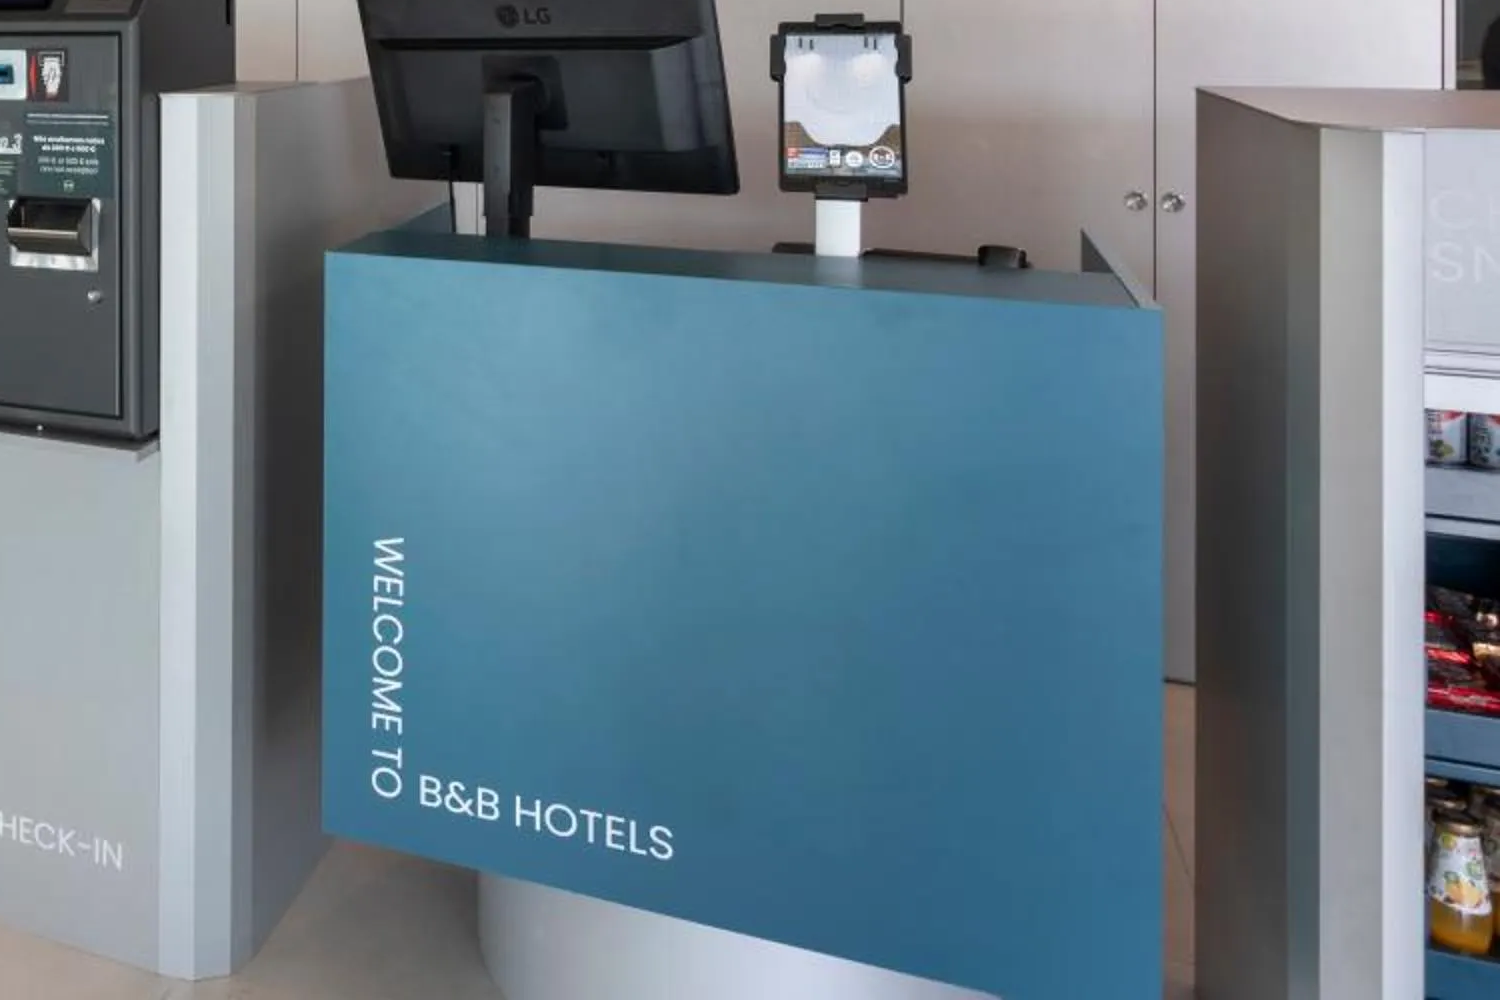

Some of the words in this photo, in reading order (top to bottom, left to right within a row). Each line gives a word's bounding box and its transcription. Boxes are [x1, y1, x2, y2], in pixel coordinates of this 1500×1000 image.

[524, 6, 552, 25] LG
[371, 536, 405, 735] WELCOME
[371, 747, 403, 799] TO
[418, 774, 500, 821] B&B
[514, 794, 674, 861] HOTELS
